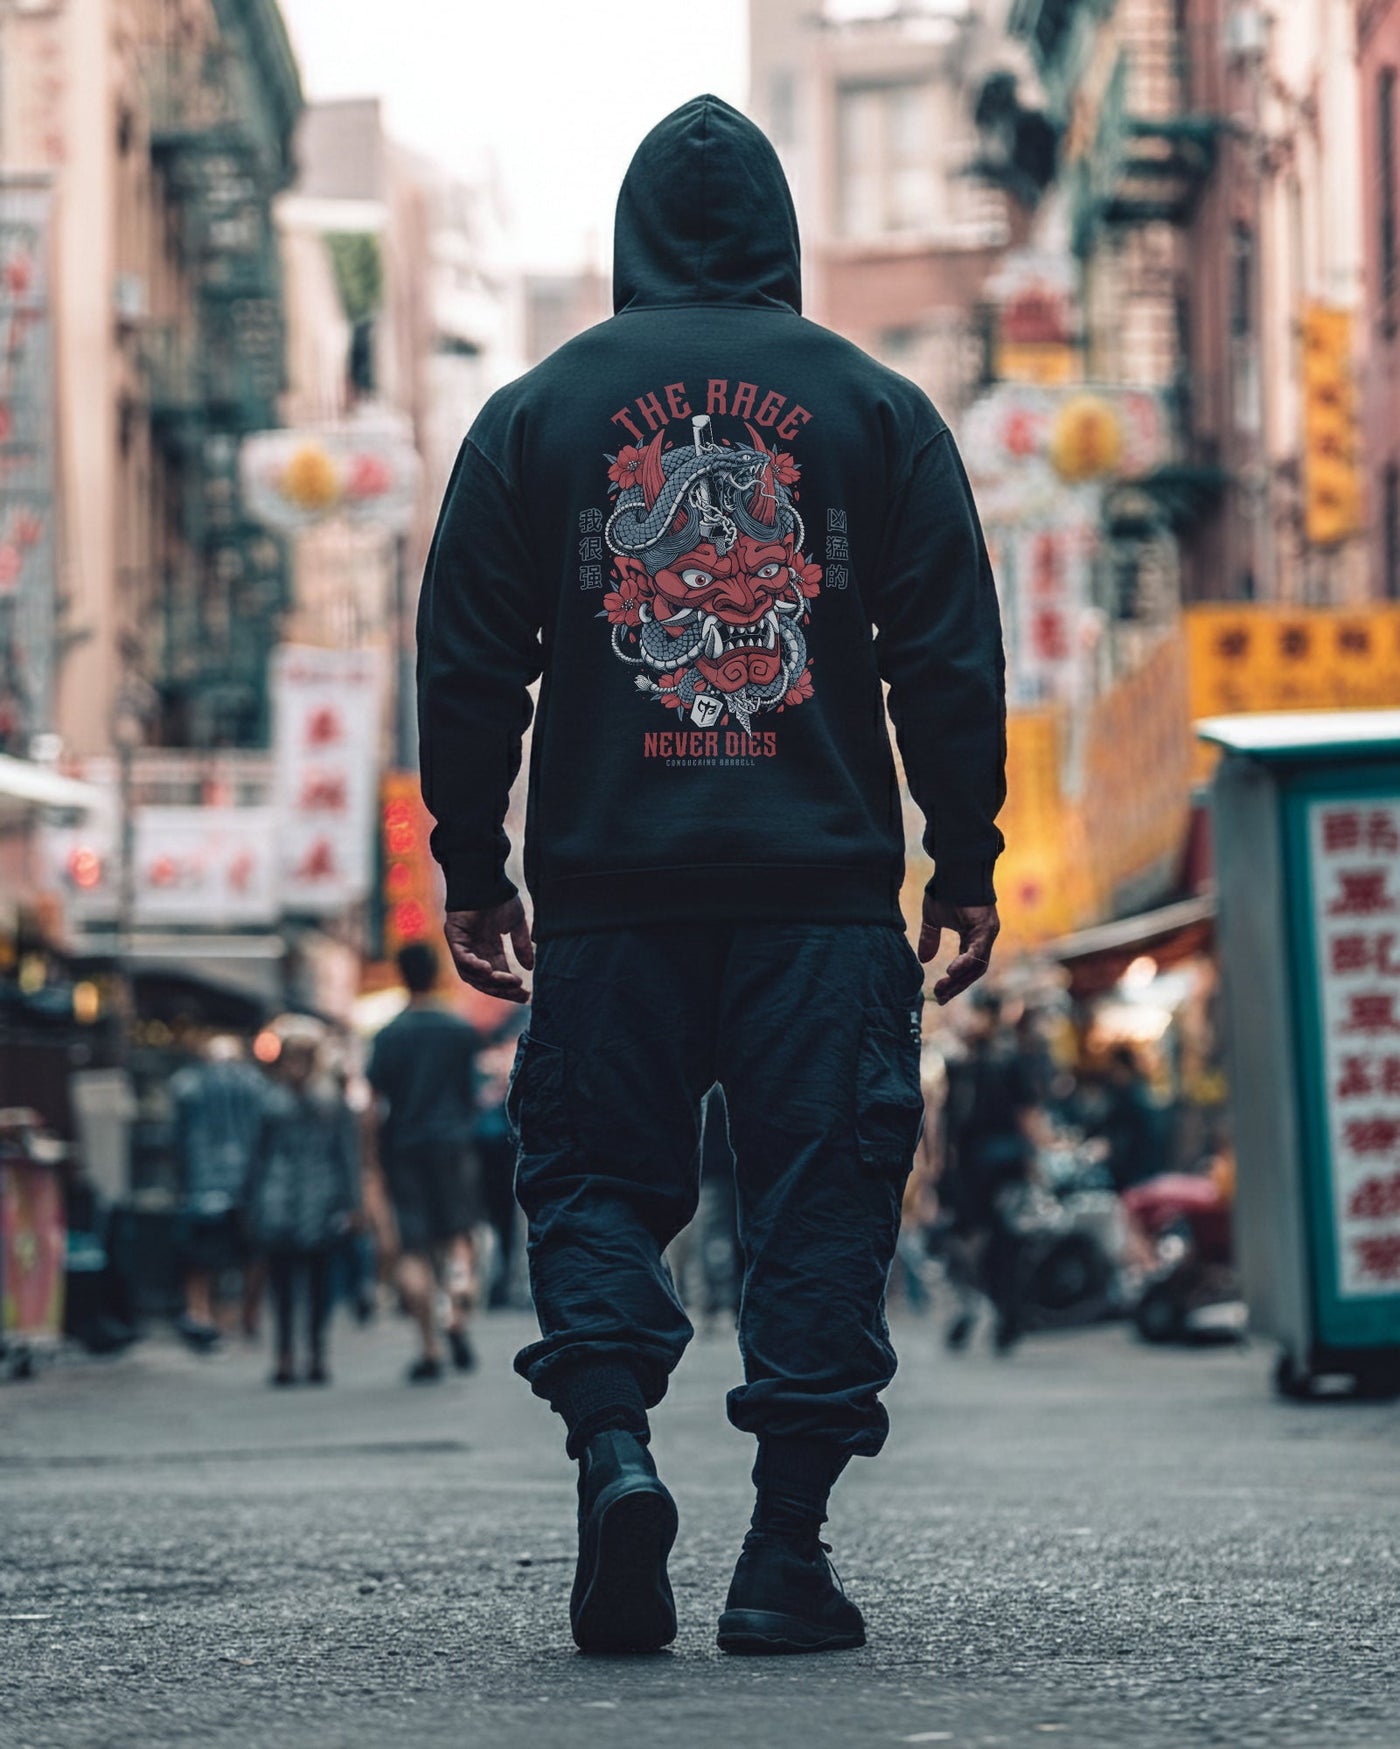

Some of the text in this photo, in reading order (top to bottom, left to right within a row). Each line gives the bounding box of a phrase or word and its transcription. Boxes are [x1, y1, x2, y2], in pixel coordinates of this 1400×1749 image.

[611, 379, 813, 440] THE RAGE
[578, 508, 603, 591] 我很强
[826, 508, 849, 590] 凶猛的
[644, 732, 777, 758] NEVER DIES
[666, 759, 716, 767] CONQUERING
